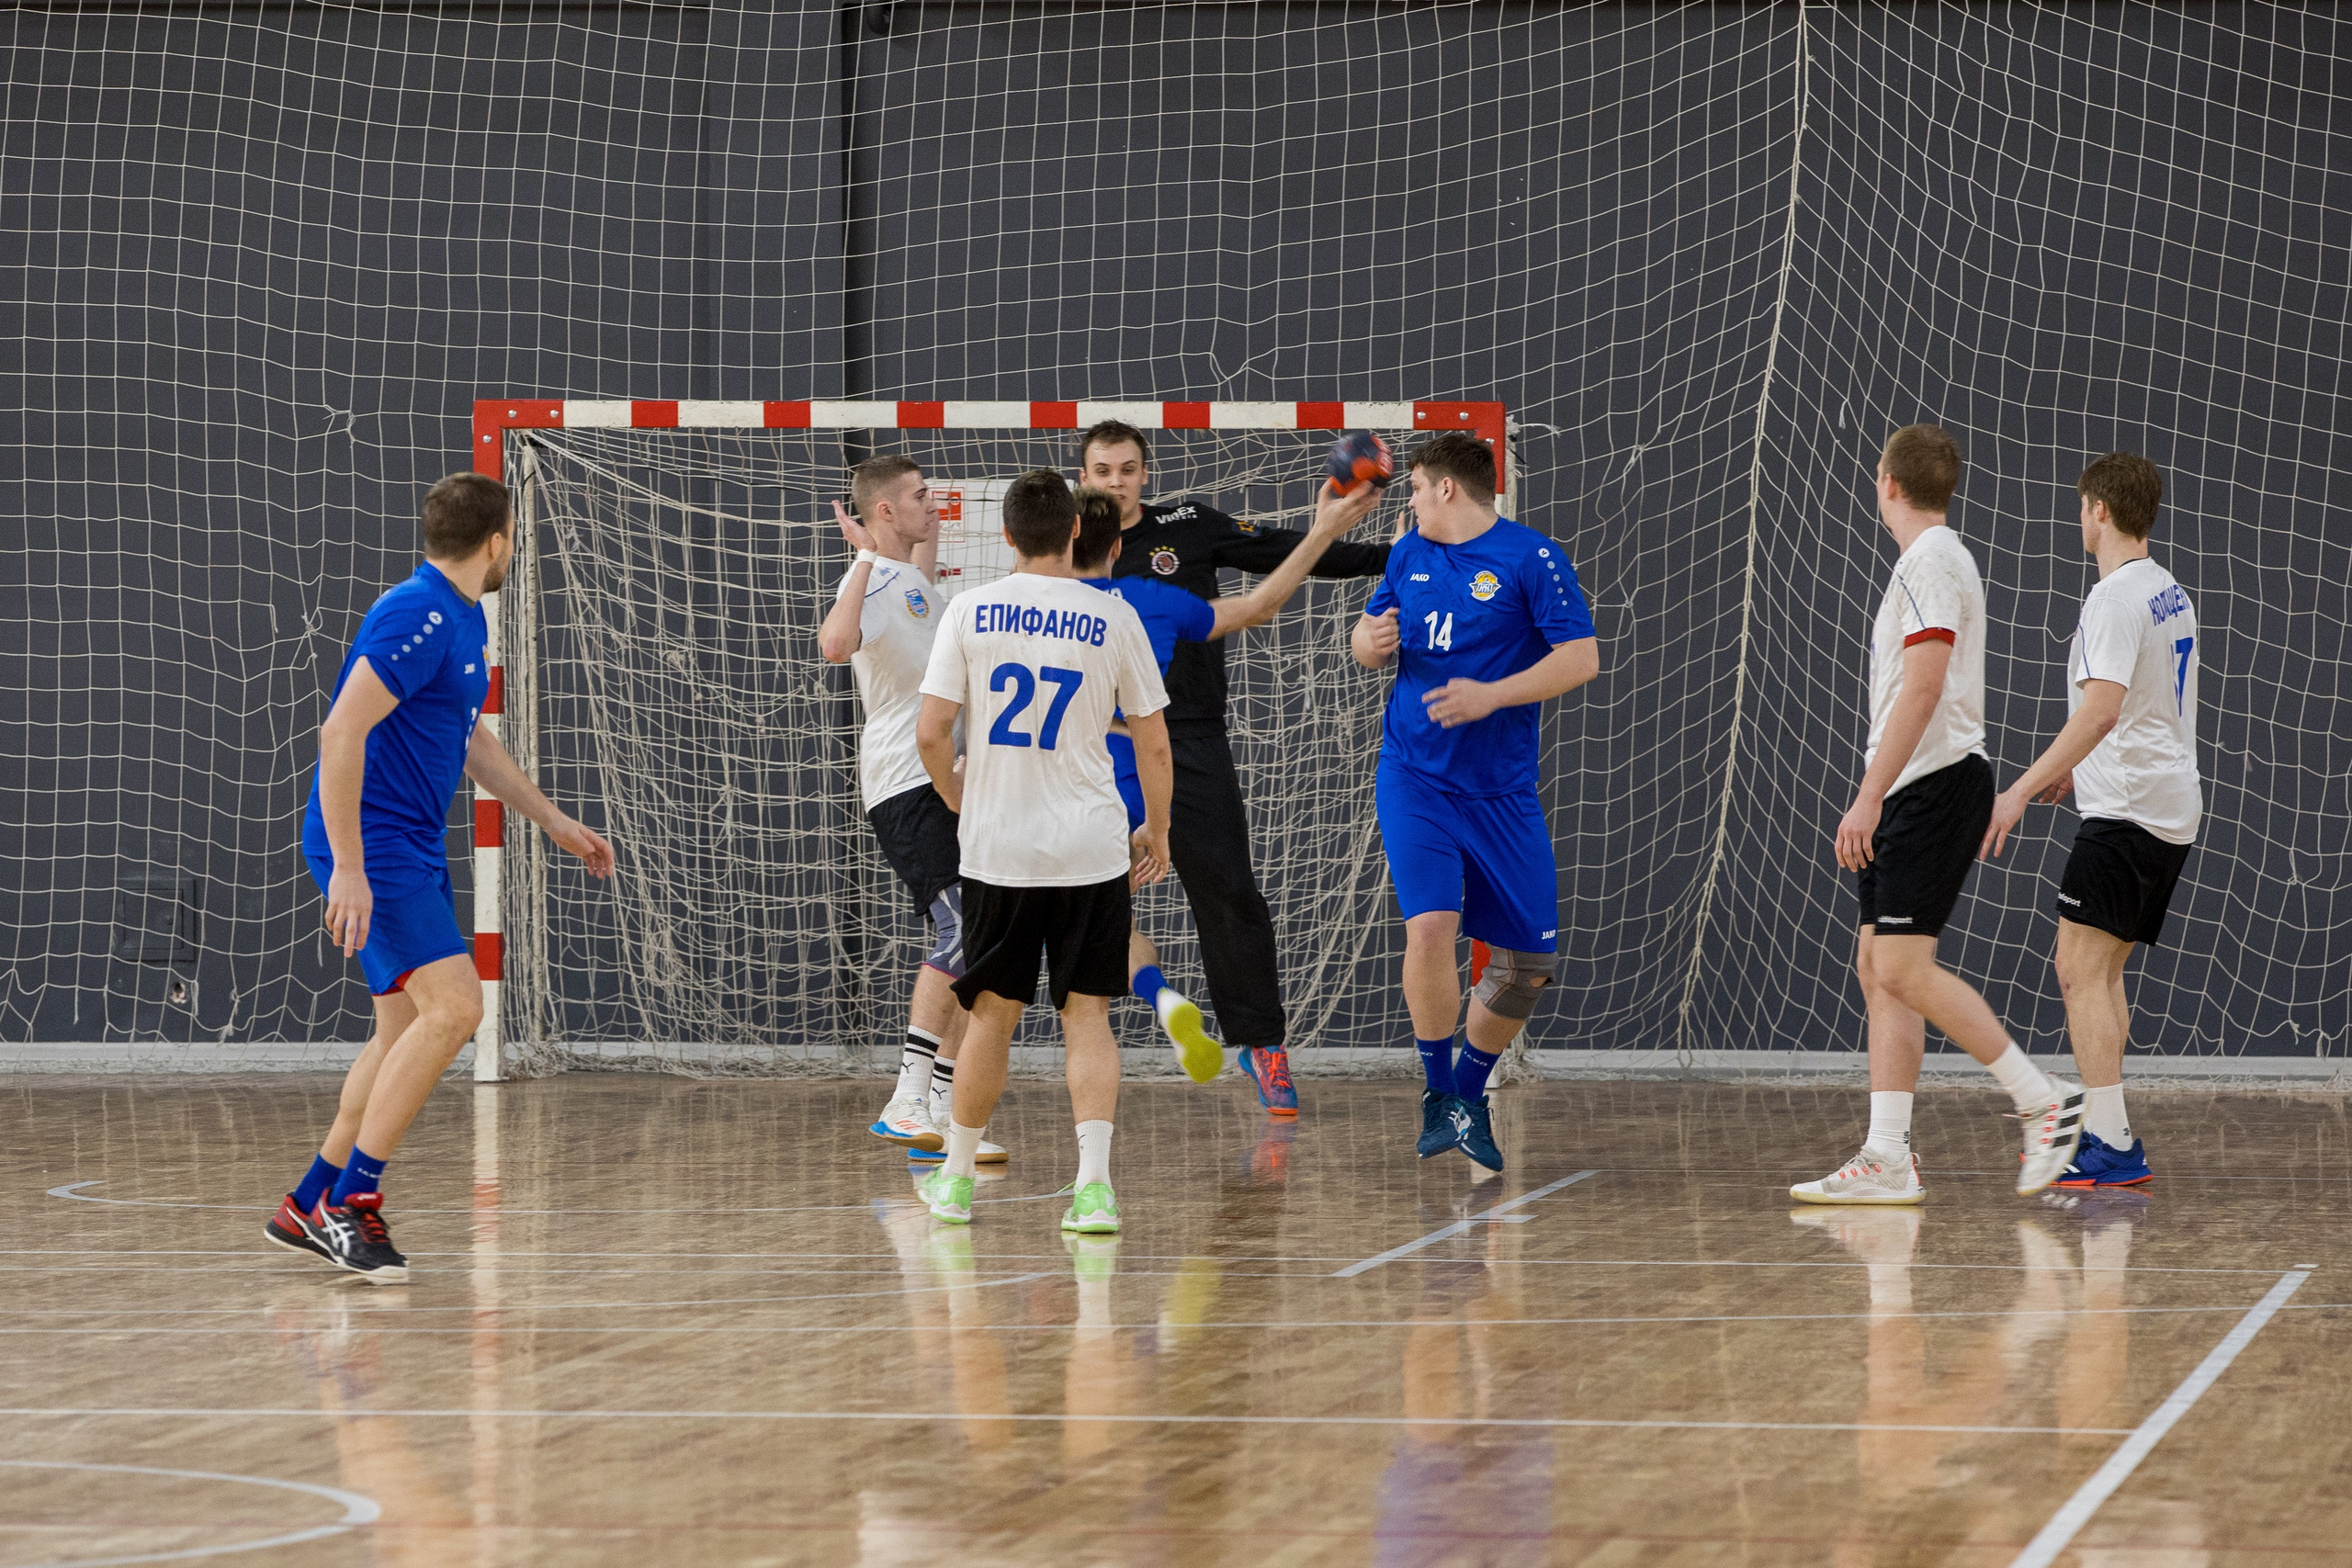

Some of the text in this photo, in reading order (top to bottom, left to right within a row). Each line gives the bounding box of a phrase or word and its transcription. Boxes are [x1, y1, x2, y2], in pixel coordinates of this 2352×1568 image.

[1410, 573, 1430, 581] JAKO
[975, 604, 1108, 647] ЕПИФАНОВ
[1424, 610, 1453, 651] 14
[988, 661, 1083, 750] 27
